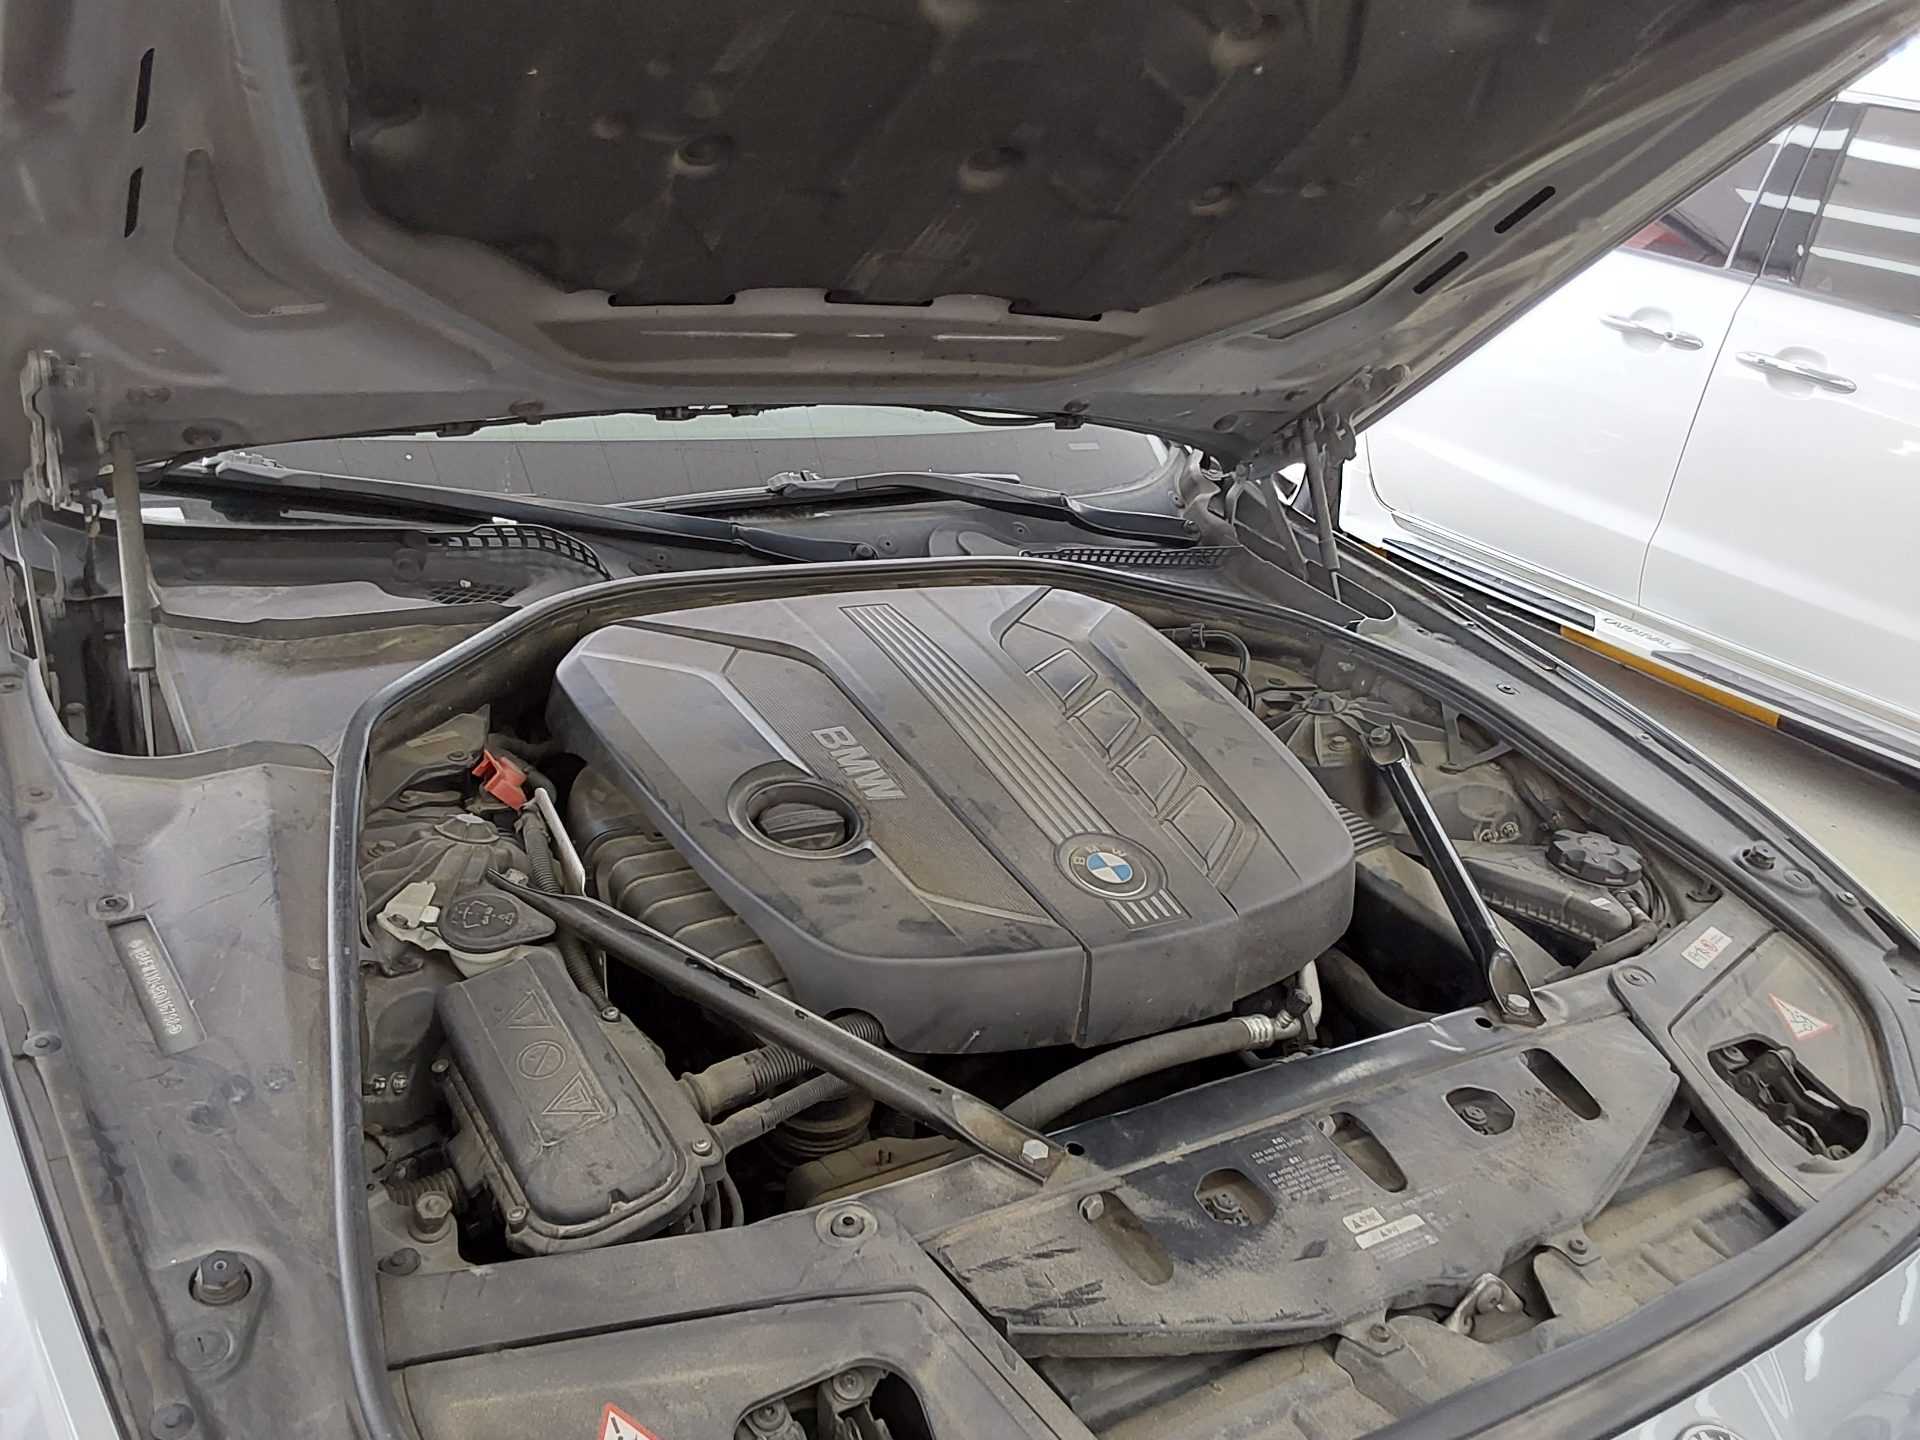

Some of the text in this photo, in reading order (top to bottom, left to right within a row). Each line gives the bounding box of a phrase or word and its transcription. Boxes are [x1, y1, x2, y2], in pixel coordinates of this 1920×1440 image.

[1602, 617, 1673, 648] CARNIVAL
[811, 725, 908, 801] BMW
[1073, 845, 1128, 866] BMW
